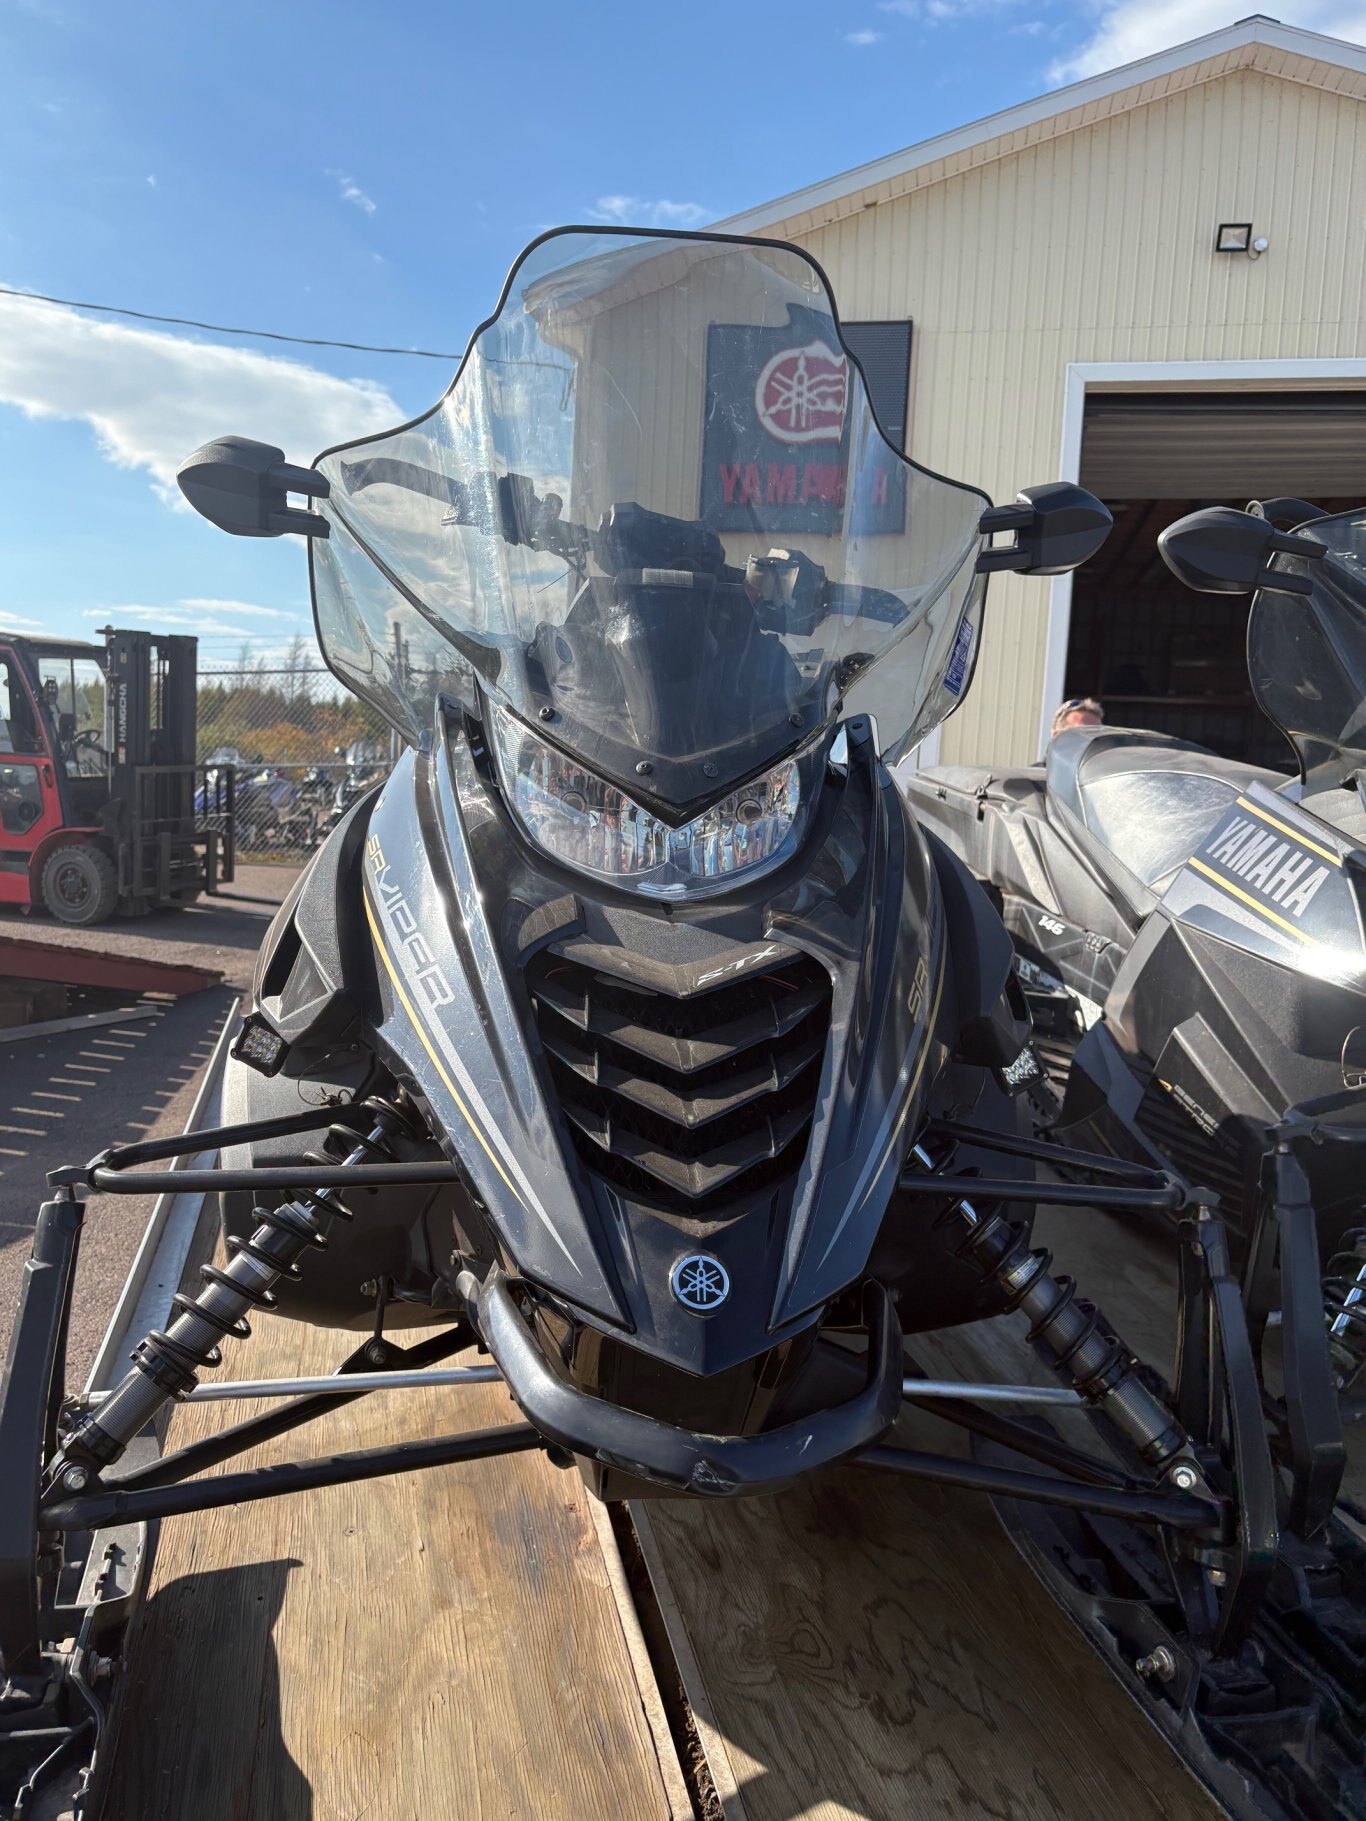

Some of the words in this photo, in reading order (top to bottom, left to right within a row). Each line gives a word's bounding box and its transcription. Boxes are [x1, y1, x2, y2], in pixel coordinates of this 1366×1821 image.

[719, 463, 889, 507] YAMAA
[119, 683, 127, 743] HANGCHA
[1205, 816, 1330, 918] YAMAHA
[1038, 915, 1066, 936] 146
